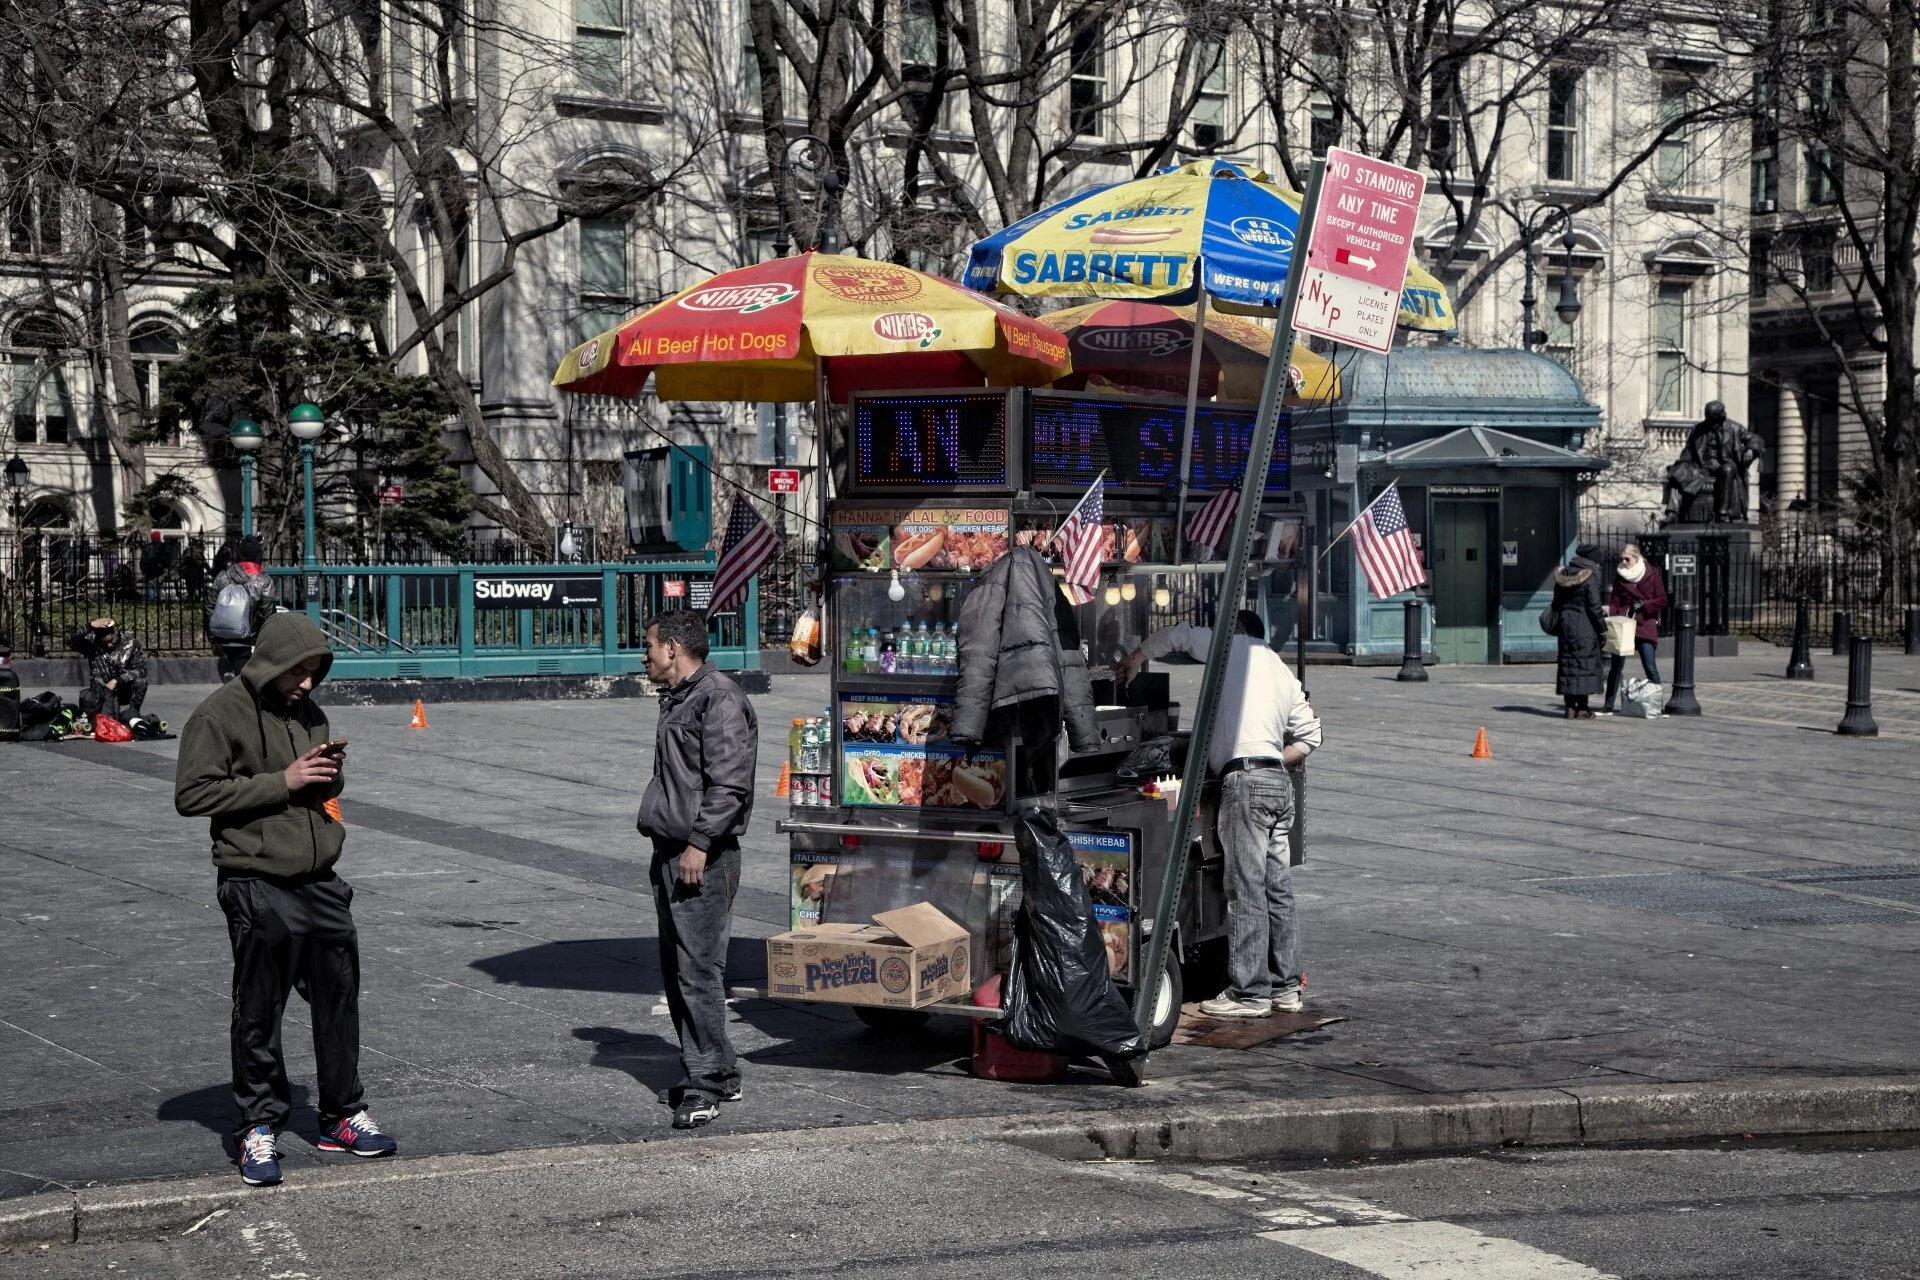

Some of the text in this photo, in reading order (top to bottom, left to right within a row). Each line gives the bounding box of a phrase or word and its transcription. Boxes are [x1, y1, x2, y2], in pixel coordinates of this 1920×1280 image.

[1331, 161, 1416, 200] NO STANDING
[1337, 192, 1399, 225] ANY TIME
[1064, 206, 1195, 231] SABRETT
[1327, 215, 1405, 245] EXCEPT AUTHORIZED
[1346, 234, 1382, 251] VEHICLES
[1013, 250, 1188, 287] SABRETT
[843, 284, 912, 296] BRAND
[1214, 273, 1281, 295] WE'RE ON A
[695, 286, 776, 307] NIKAS
[1358, 295, 1389, 312] LICENSE
[879, 314, 926, 336] NIKAS
[1356, 311, 1384, 325] PLATES
[1095, 331, 1170, 349] NIKAS
[1358, 326, 1379, 339] ONLY
[629, 332, 787, 356] All Beef Hot Dogs
[1003, 323, 1066, 362] All Beef Sausages
[893, 511, 938, 523] HALAL
[965, 511, 1005, 523] FOOD
[475, 580, 554, 601] Subway
[900, 751, 948, 760] CHICKEN KEBAB
[1068, 835, 1126, 848] SHISH KEBAB
[792, 854, 828, 863] ITALIAN
[799, 911, 821, 920] CHIC
[1099, 908, 1118, 917] DOG
[821, 957, 844, 972] New
[844, 950, 871, 969] York
[804, 957, 879, 992] Pretzel
